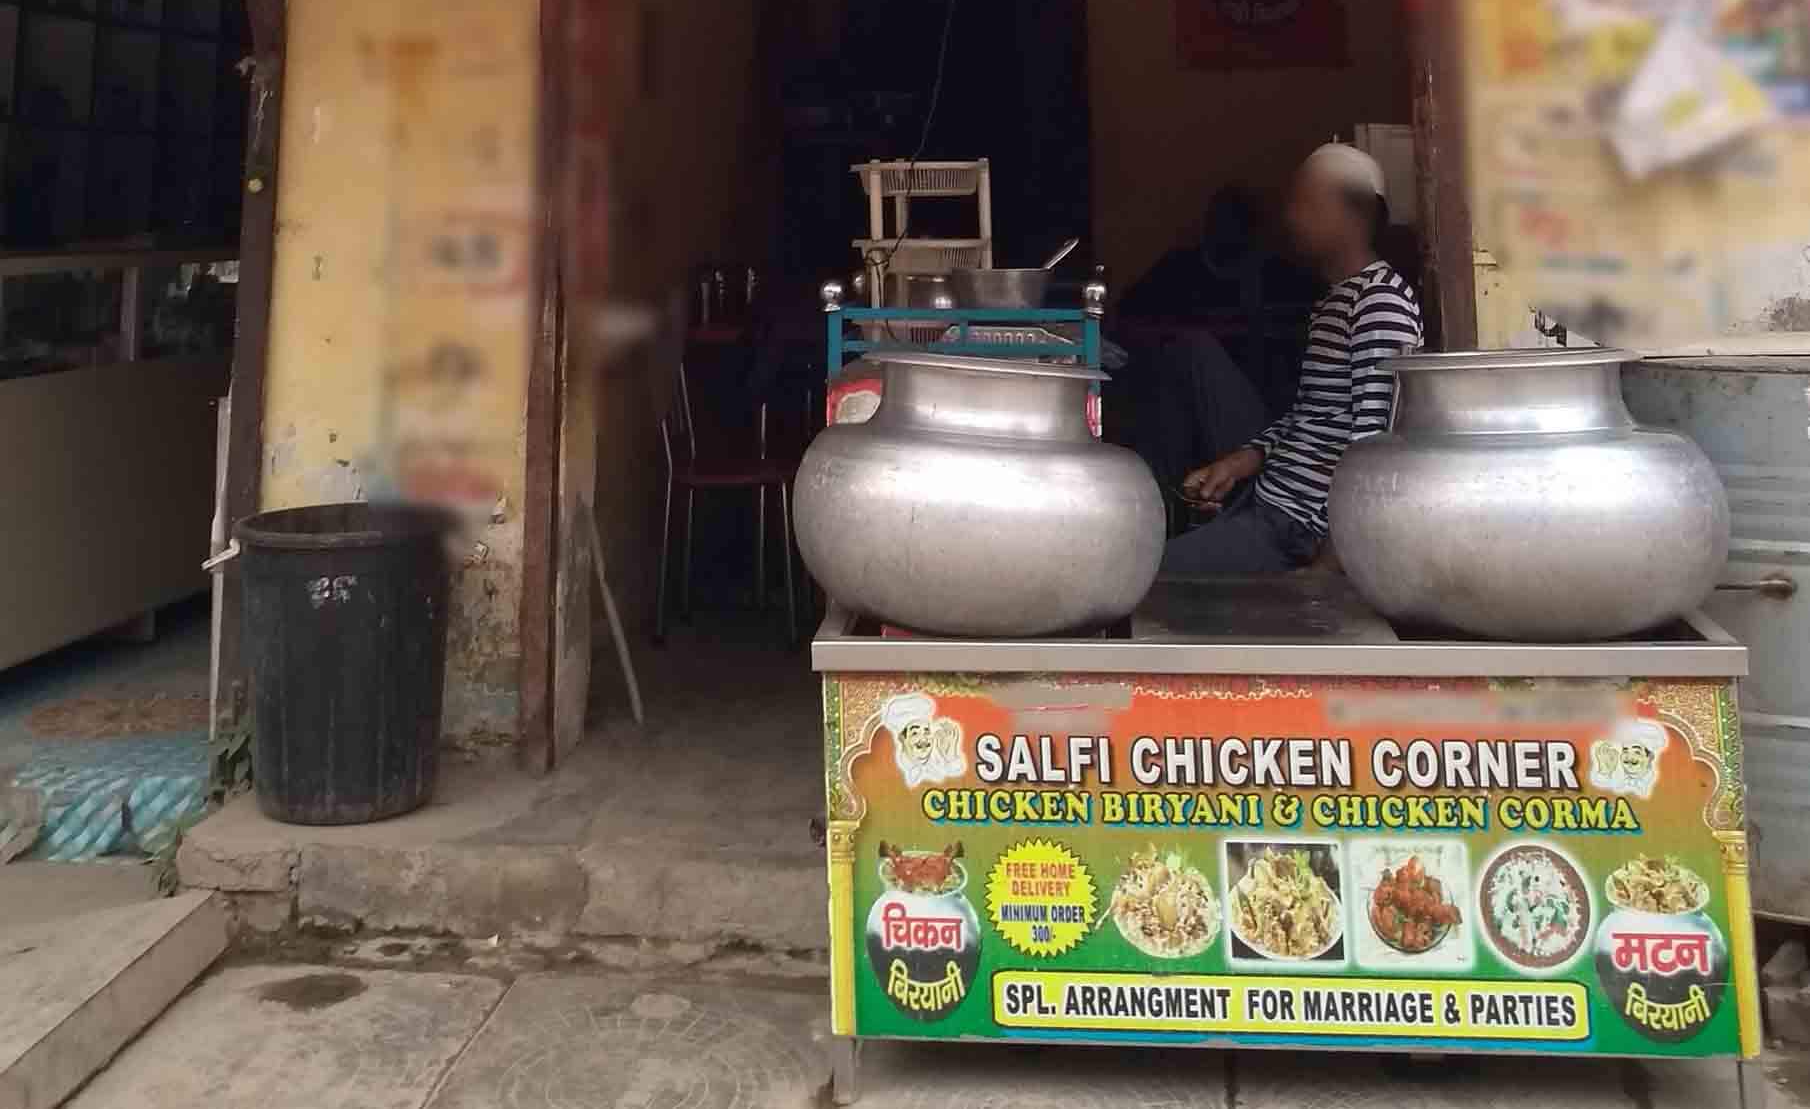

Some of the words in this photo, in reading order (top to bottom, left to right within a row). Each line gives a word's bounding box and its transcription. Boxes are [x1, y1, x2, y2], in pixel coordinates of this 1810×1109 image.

[976, 733, 1112, 785] SALFI
[1131, 736, 1354, 789] CHICKEN
[1371, 739, 1579, 790] CORNER
[922, 790, 1091, 826] CHICKEN
[1102, 792, 1263, 827] BIRYANI
[1271, 796, 1300, 827] &
[1311, 795, 1490, 830] CHICKEN
[1498, 797, 1642, 832] CORMA
[1006, 863, 1037, 879] FREE
[1040, 863, 1076, 879] HOME
[1011, 881, 1071, 897] DELIVERY
[882, 902, 962, 951] चिकन
[1001, 904, 1047, 922] MINIMUM
[1051, 905, 1085, 923] ORDER
[1612, 931, 1710, 975] मटन
[887, 958, 966, 1012] बिरयानी
[1006, 983, 1057, 1016] SPL.
[1065, 986, 1232, 1020] ARRANGMENT
[1247, 990, 1295, 1021] FOR
[1303, 990, 1434, 1024] MARRIAGE
[1444, 994, 1461, 1024] &
[1471, 994, 1577, 1027] PARTIES
[1623, 983, 1711, 1031] बिरयानी
